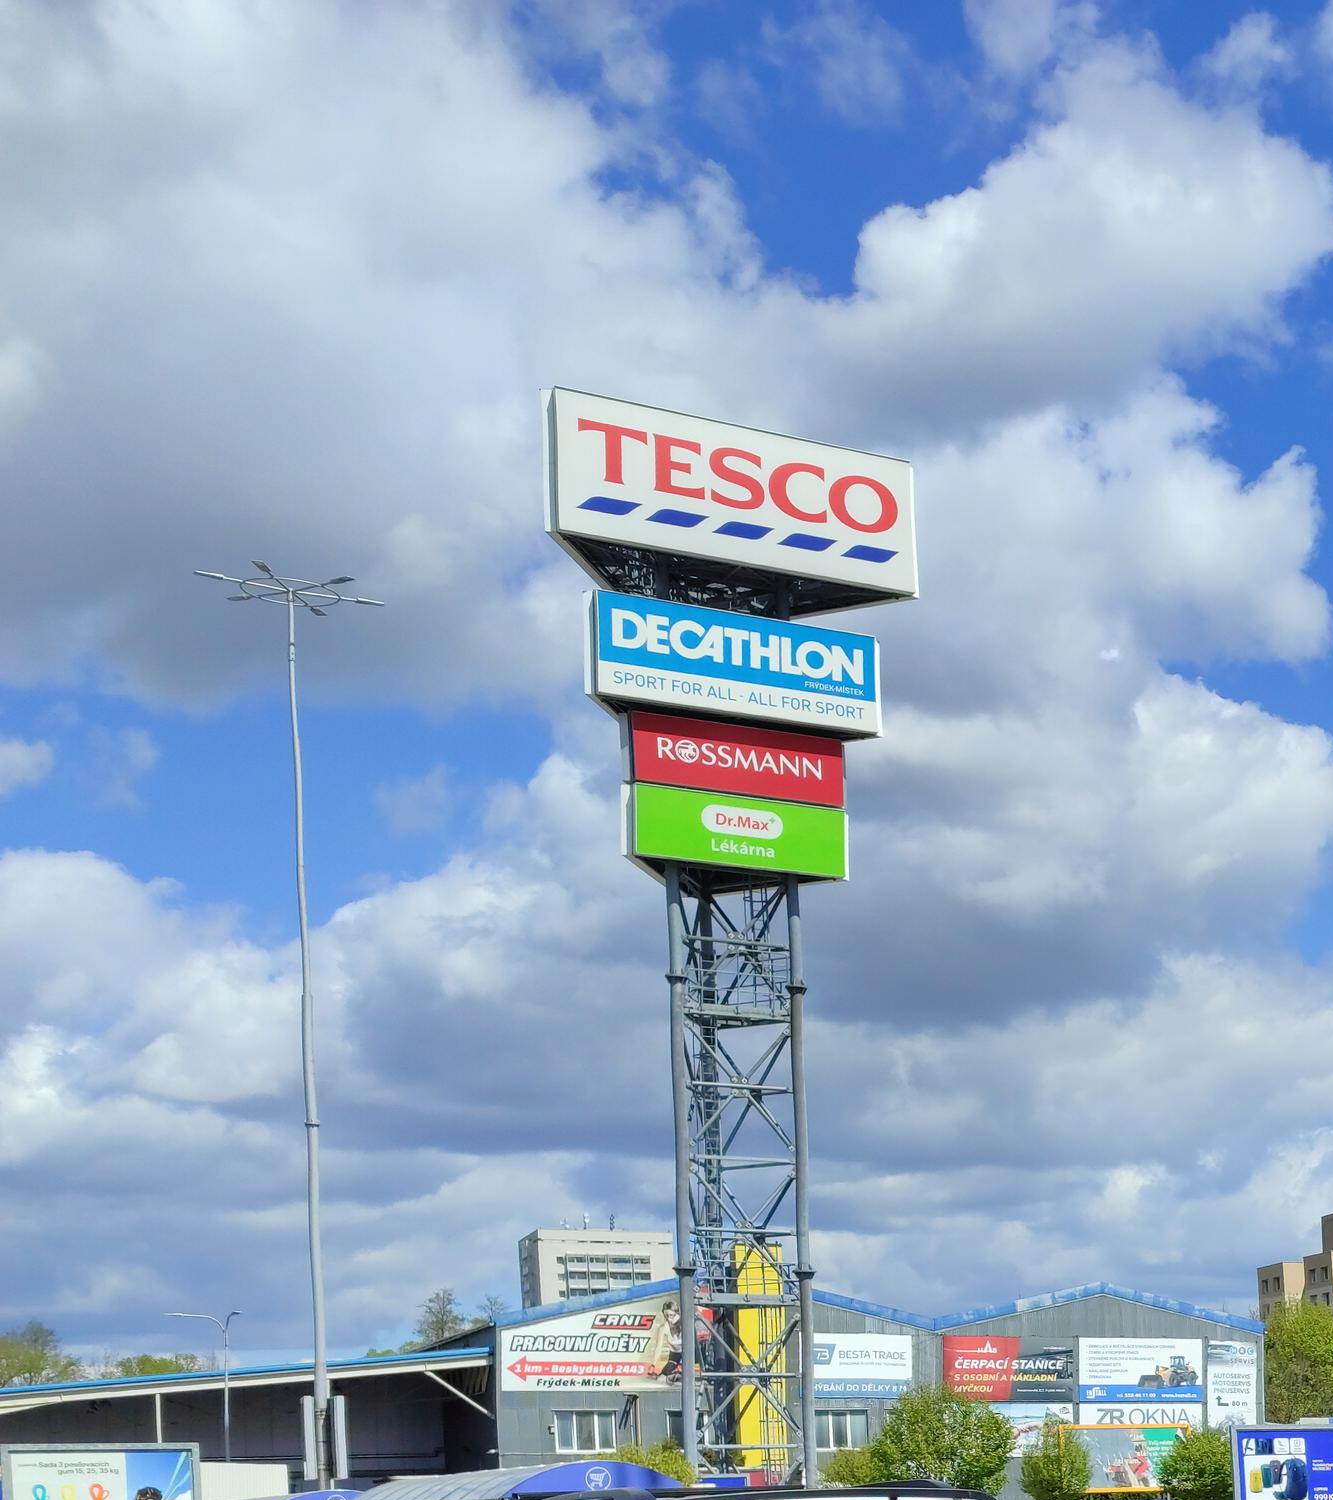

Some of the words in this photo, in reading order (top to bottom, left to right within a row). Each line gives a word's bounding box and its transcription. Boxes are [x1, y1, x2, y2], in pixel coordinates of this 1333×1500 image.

[578, 418, 898, 533] TESCO
[611, 607, 864, 685] DECATHLON
[613, 671, 667, 691] SPORT
[671, 679, 703, 696] FOR
[707, 685, 736, 701] ALL
[748, 691, 777, 707] ALL
[782, 696, 812, 713] FOR
[816, 700, 865, 720] SPORT
[804, 680, 865, 697] FRÝDEK-MÍSTEK
[656, 736, 823, 781] ROSSMANN
[715, 812, 769, 831] Dr.Max
[711, 838, 775, 858] Lékárna
[592, 1314, 656, 1329] CANIS
[510, 1333, 597, 1352] PRACOVNÍ
[596, 1334, 650, 1353] ODĚVY
[838, 1350, 871, 1359] BESTA
[873, 1351, 906, 1361] TRADE
[954, 1356, 1010, 1369] ČERPACÍ
[1011, 1359, 1065, 1370] STANICE
[514, 1363, 522, 1373] 1
[524, 1363, 542, 1373] km
[551, 1363, 613, 1377] Beskydská
[615, 1364, 645, 1374] 2443
[962, 1372, 1000, 1381] OSOBNÍ
[1009, 1371, 1058, 1382] NÁKLADNÍ
[536, 1377, 621, 1389] Frýdek-Místek
[846, 1384, 860, 1392] DO
[954, 1383, 993, 1393] MYČKOU
[1128, 1408, 1191, 1425] OKNA
[1314, 1493, 1329, 1500] 999
